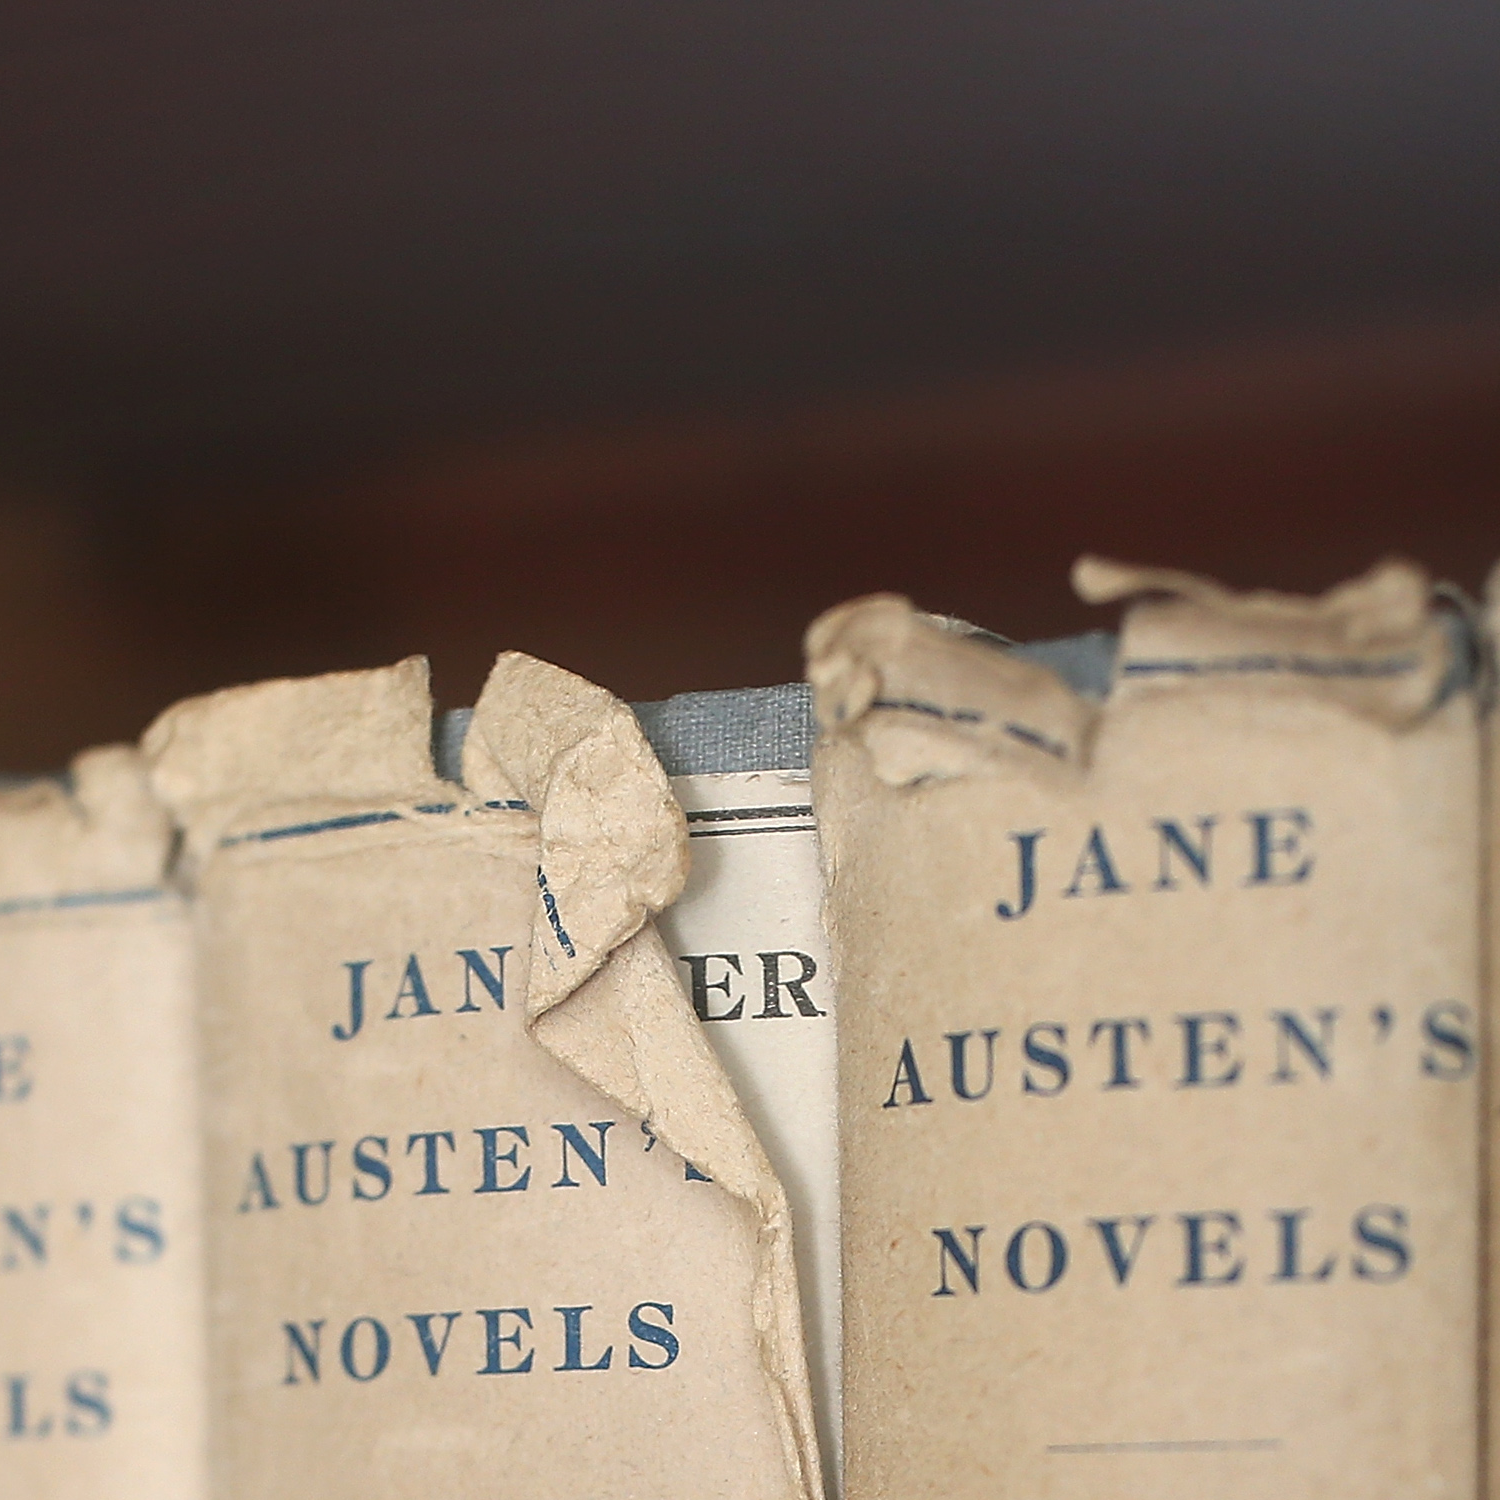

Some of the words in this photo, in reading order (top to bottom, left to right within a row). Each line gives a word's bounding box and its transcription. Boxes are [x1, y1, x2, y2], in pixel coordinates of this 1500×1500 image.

[996, 808, 1317, 920] JANE
[331, 946, 514, 1042] JAN
[883, 1001, 1477, 1109] AUSTEN'S
[238, 1120, 715, 1212] AUSTEN'
[932, 1204, 1412, 1296] NOVELS
[282, 1302, 681, 1382] NOVELS
